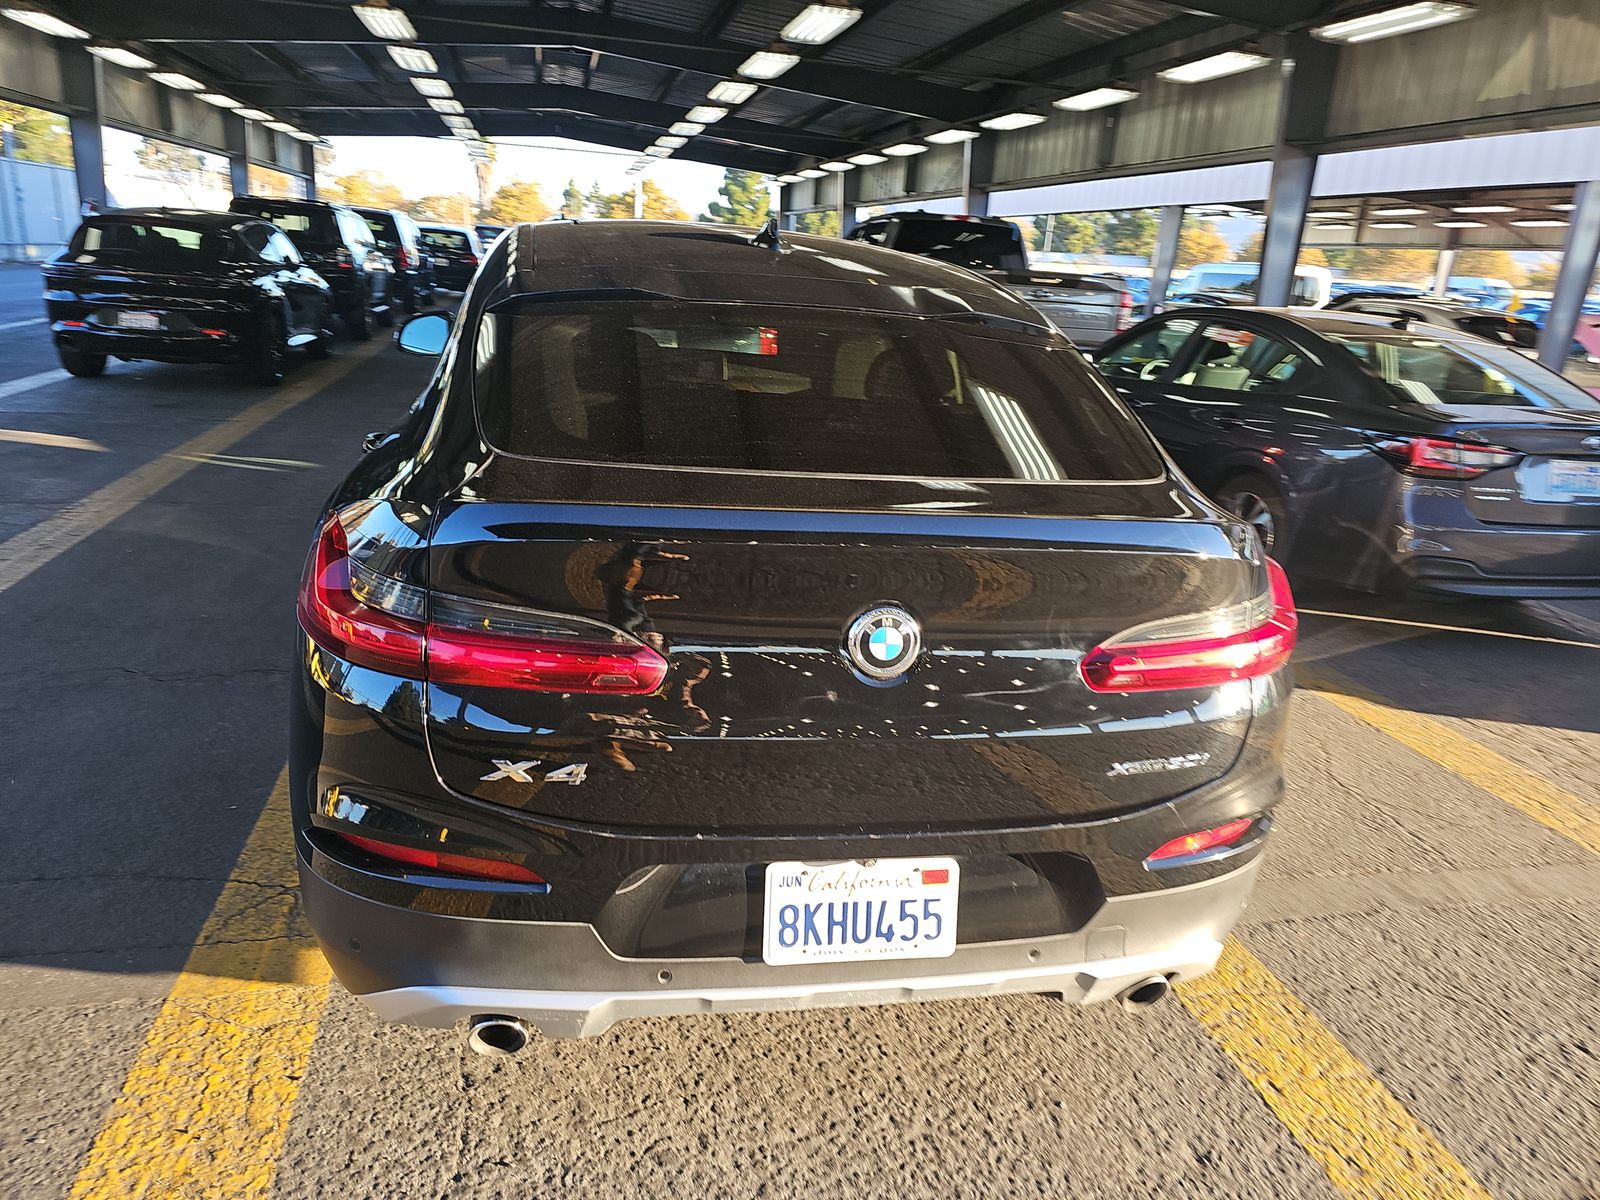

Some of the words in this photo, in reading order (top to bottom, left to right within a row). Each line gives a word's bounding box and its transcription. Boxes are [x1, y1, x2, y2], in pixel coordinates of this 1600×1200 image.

[779, 875, 802, 888] JUN
[808, 870, 914, 897] California
[778, 899, 943, 948] 8KHU455
